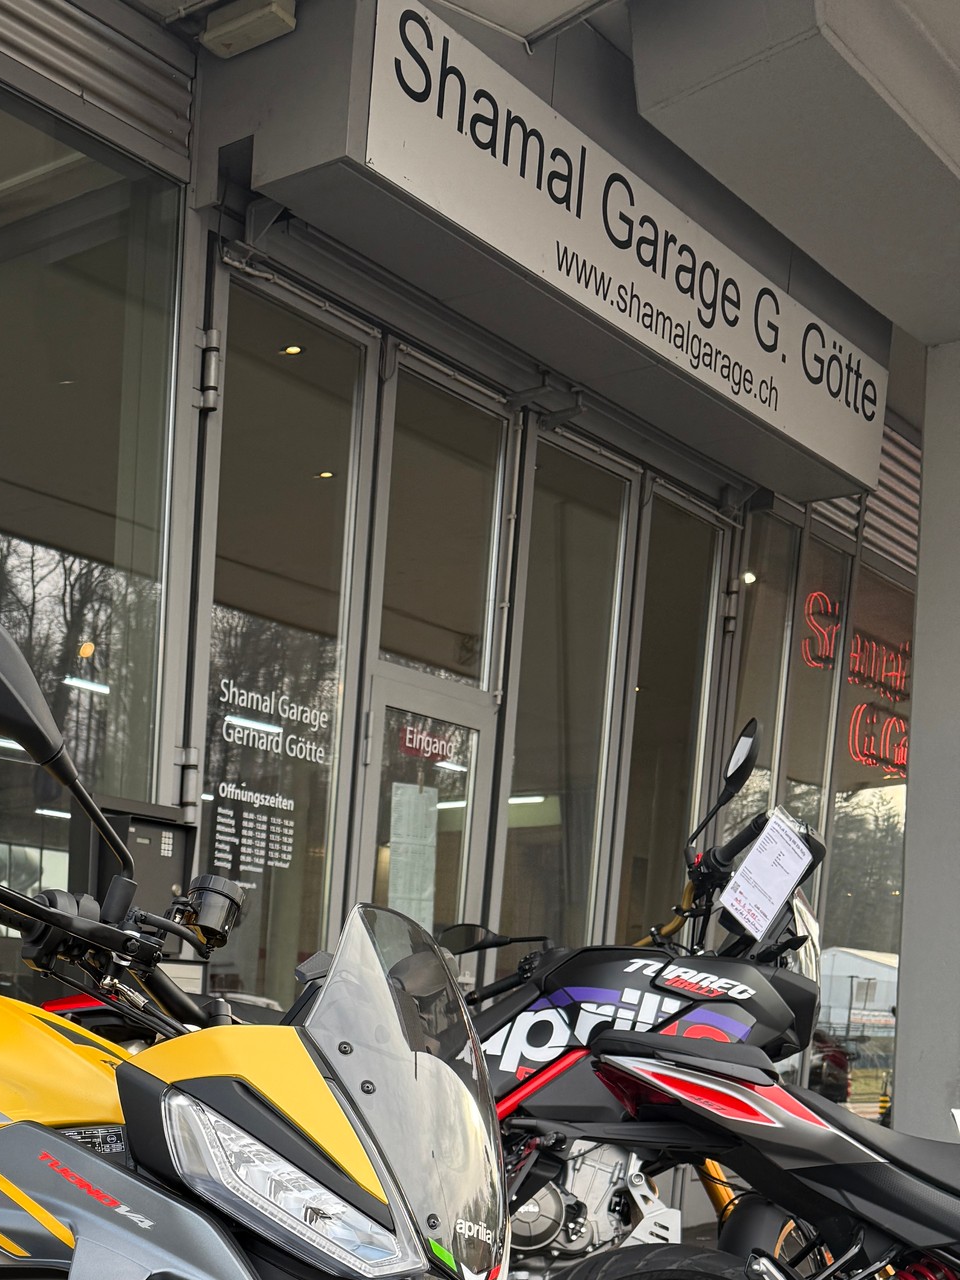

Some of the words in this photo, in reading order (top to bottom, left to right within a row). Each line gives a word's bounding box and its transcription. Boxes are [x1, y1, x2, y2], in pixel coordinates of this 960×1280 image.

[394, 9, 587, 219] Shamal
[602, 172, 741, 329] Garage
[753, 287, 787, 363] G.
[801, 322, 877, 421] Götte
[556, 240, 778, 411] www.shamalgarage.ch
[220, 679, 275, 715] Shamal
[278, 695, 329, 732] Garage
[222, 720, 283, 754] Gerhard
[285, 734, 325, 764] Götte
[405, 726, 455, 760] Eingang
[623, 957, 756, 1000] TUAREG
[664, 976, 727, 999] RALLY
[39, 1151, 121, 1208] TUONO
[114, 1204, 156, 1230] V4
[456, 1218, 493, 1245] aprilia
